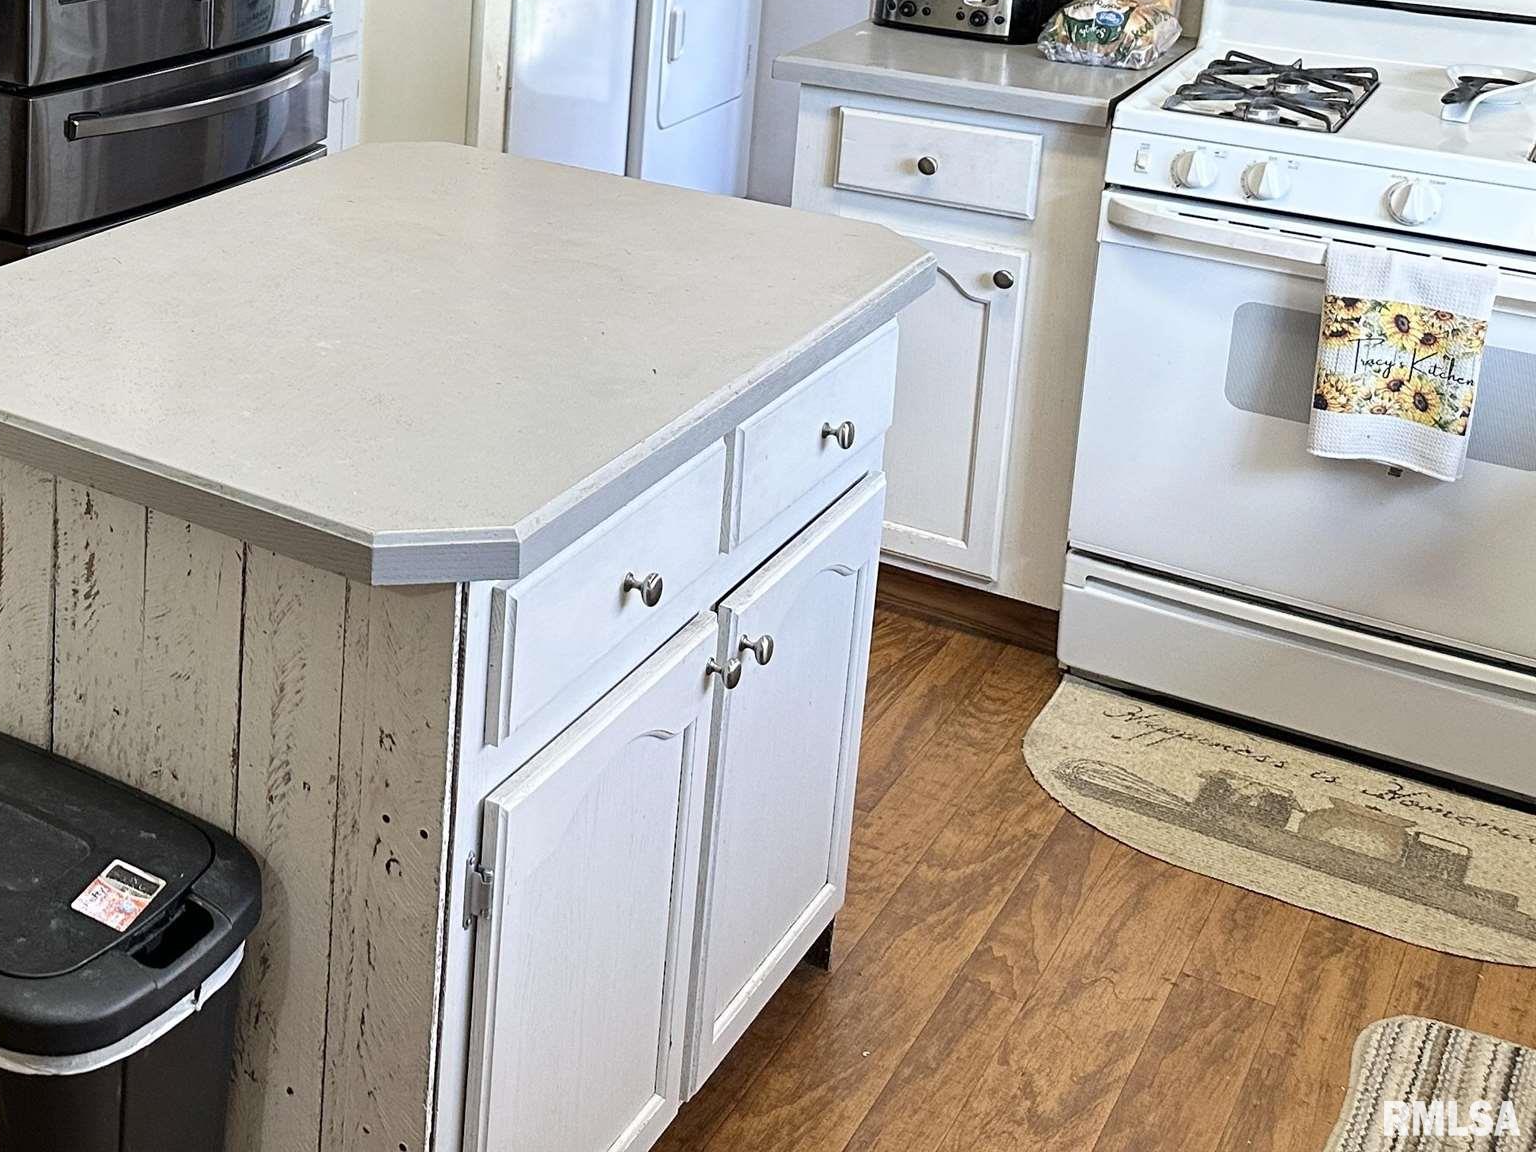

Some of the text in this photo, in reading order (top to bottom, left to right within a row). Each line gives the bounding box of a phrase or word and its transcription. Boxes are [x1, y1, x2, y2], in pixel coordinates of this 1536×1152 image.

[1347, 337, 1474, 386] Tracy's Kitchen
[1103, 706, 1289, 769] Happiness
